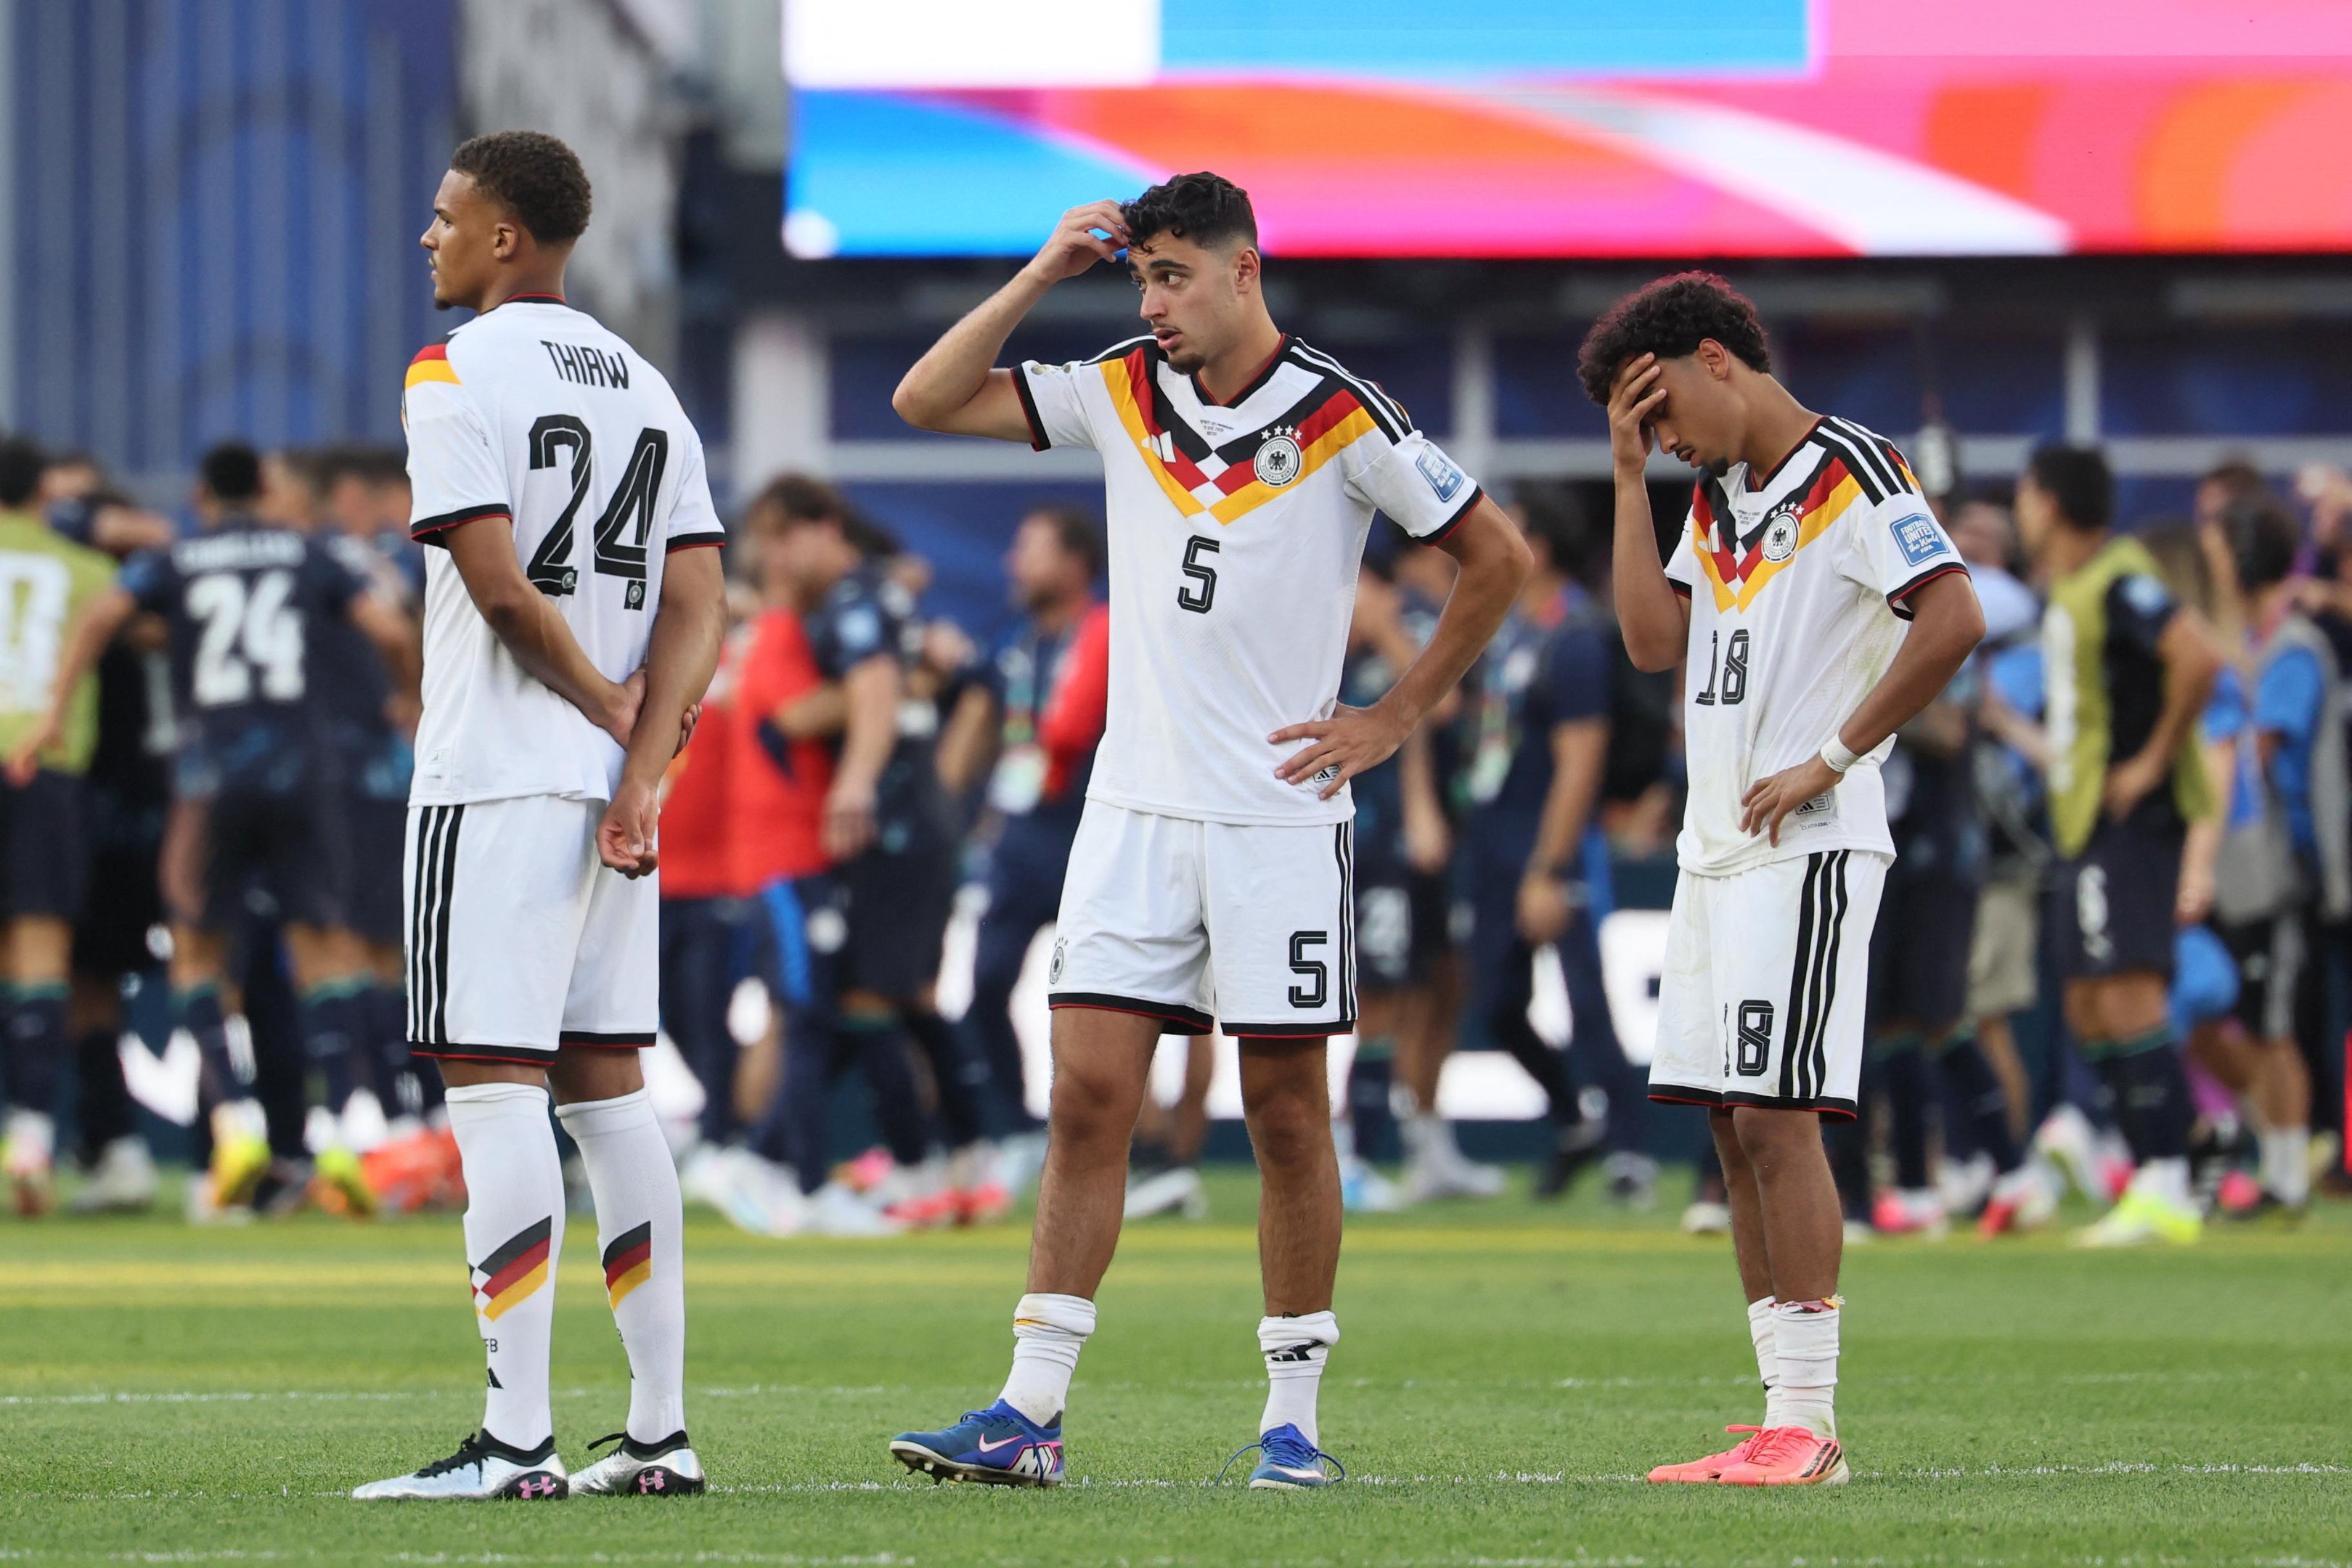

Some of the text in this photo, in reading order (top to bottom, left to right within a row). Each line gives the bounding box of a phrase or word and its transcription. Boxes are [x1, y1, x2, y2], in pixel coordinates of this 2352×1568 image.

[541, 340, 629, 390] THIAW
[527, 415, 668, 611] 24
[1900, 520, 1930, 536] FOOTBALL
[1904, 526, 1935, 544] UNITES
[1907, 534, 1940, 553] the World
[1177, 534, 1220, 614] 5
[187, 570, 305, 707] 24
[1695, 629, 1749, 706] 18
[1288, 931, 1327, 1008] 5
